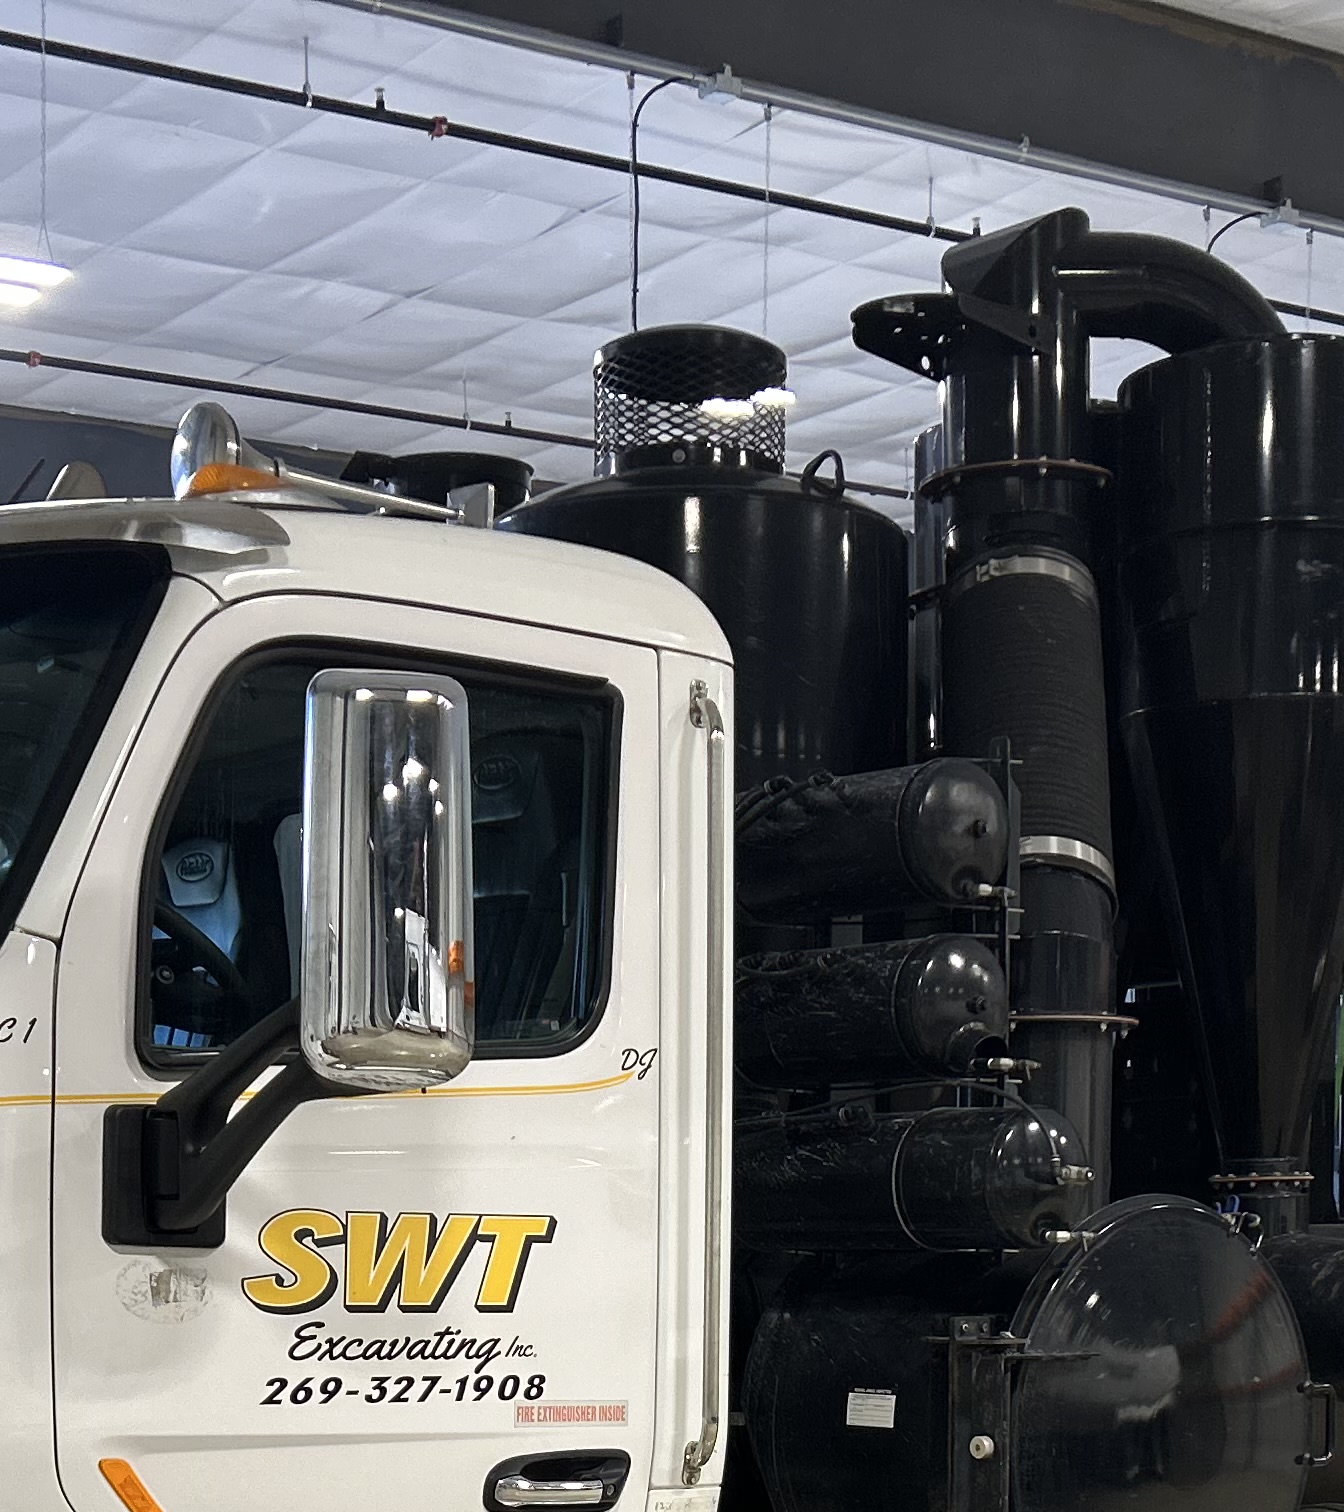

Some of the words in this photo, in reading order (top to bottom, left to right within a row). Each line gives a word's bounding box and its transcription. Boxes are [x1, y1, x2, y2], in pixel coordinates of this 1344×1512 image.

[23, 1017, 38, 1044] 1
[241, 1207, 558, 1316] SWT
[288, 1321, 502, 1375] Excavating
[505, 1334, 538, 1359] Inc.
[259, 1374, 547, 1406] 269-327-1908
[517, 1405, 535, 1422] FIRE
[537, 1405, 597, 1422] EXTINGUISHER
[598, 1404, 626, 1422] INSIDE
